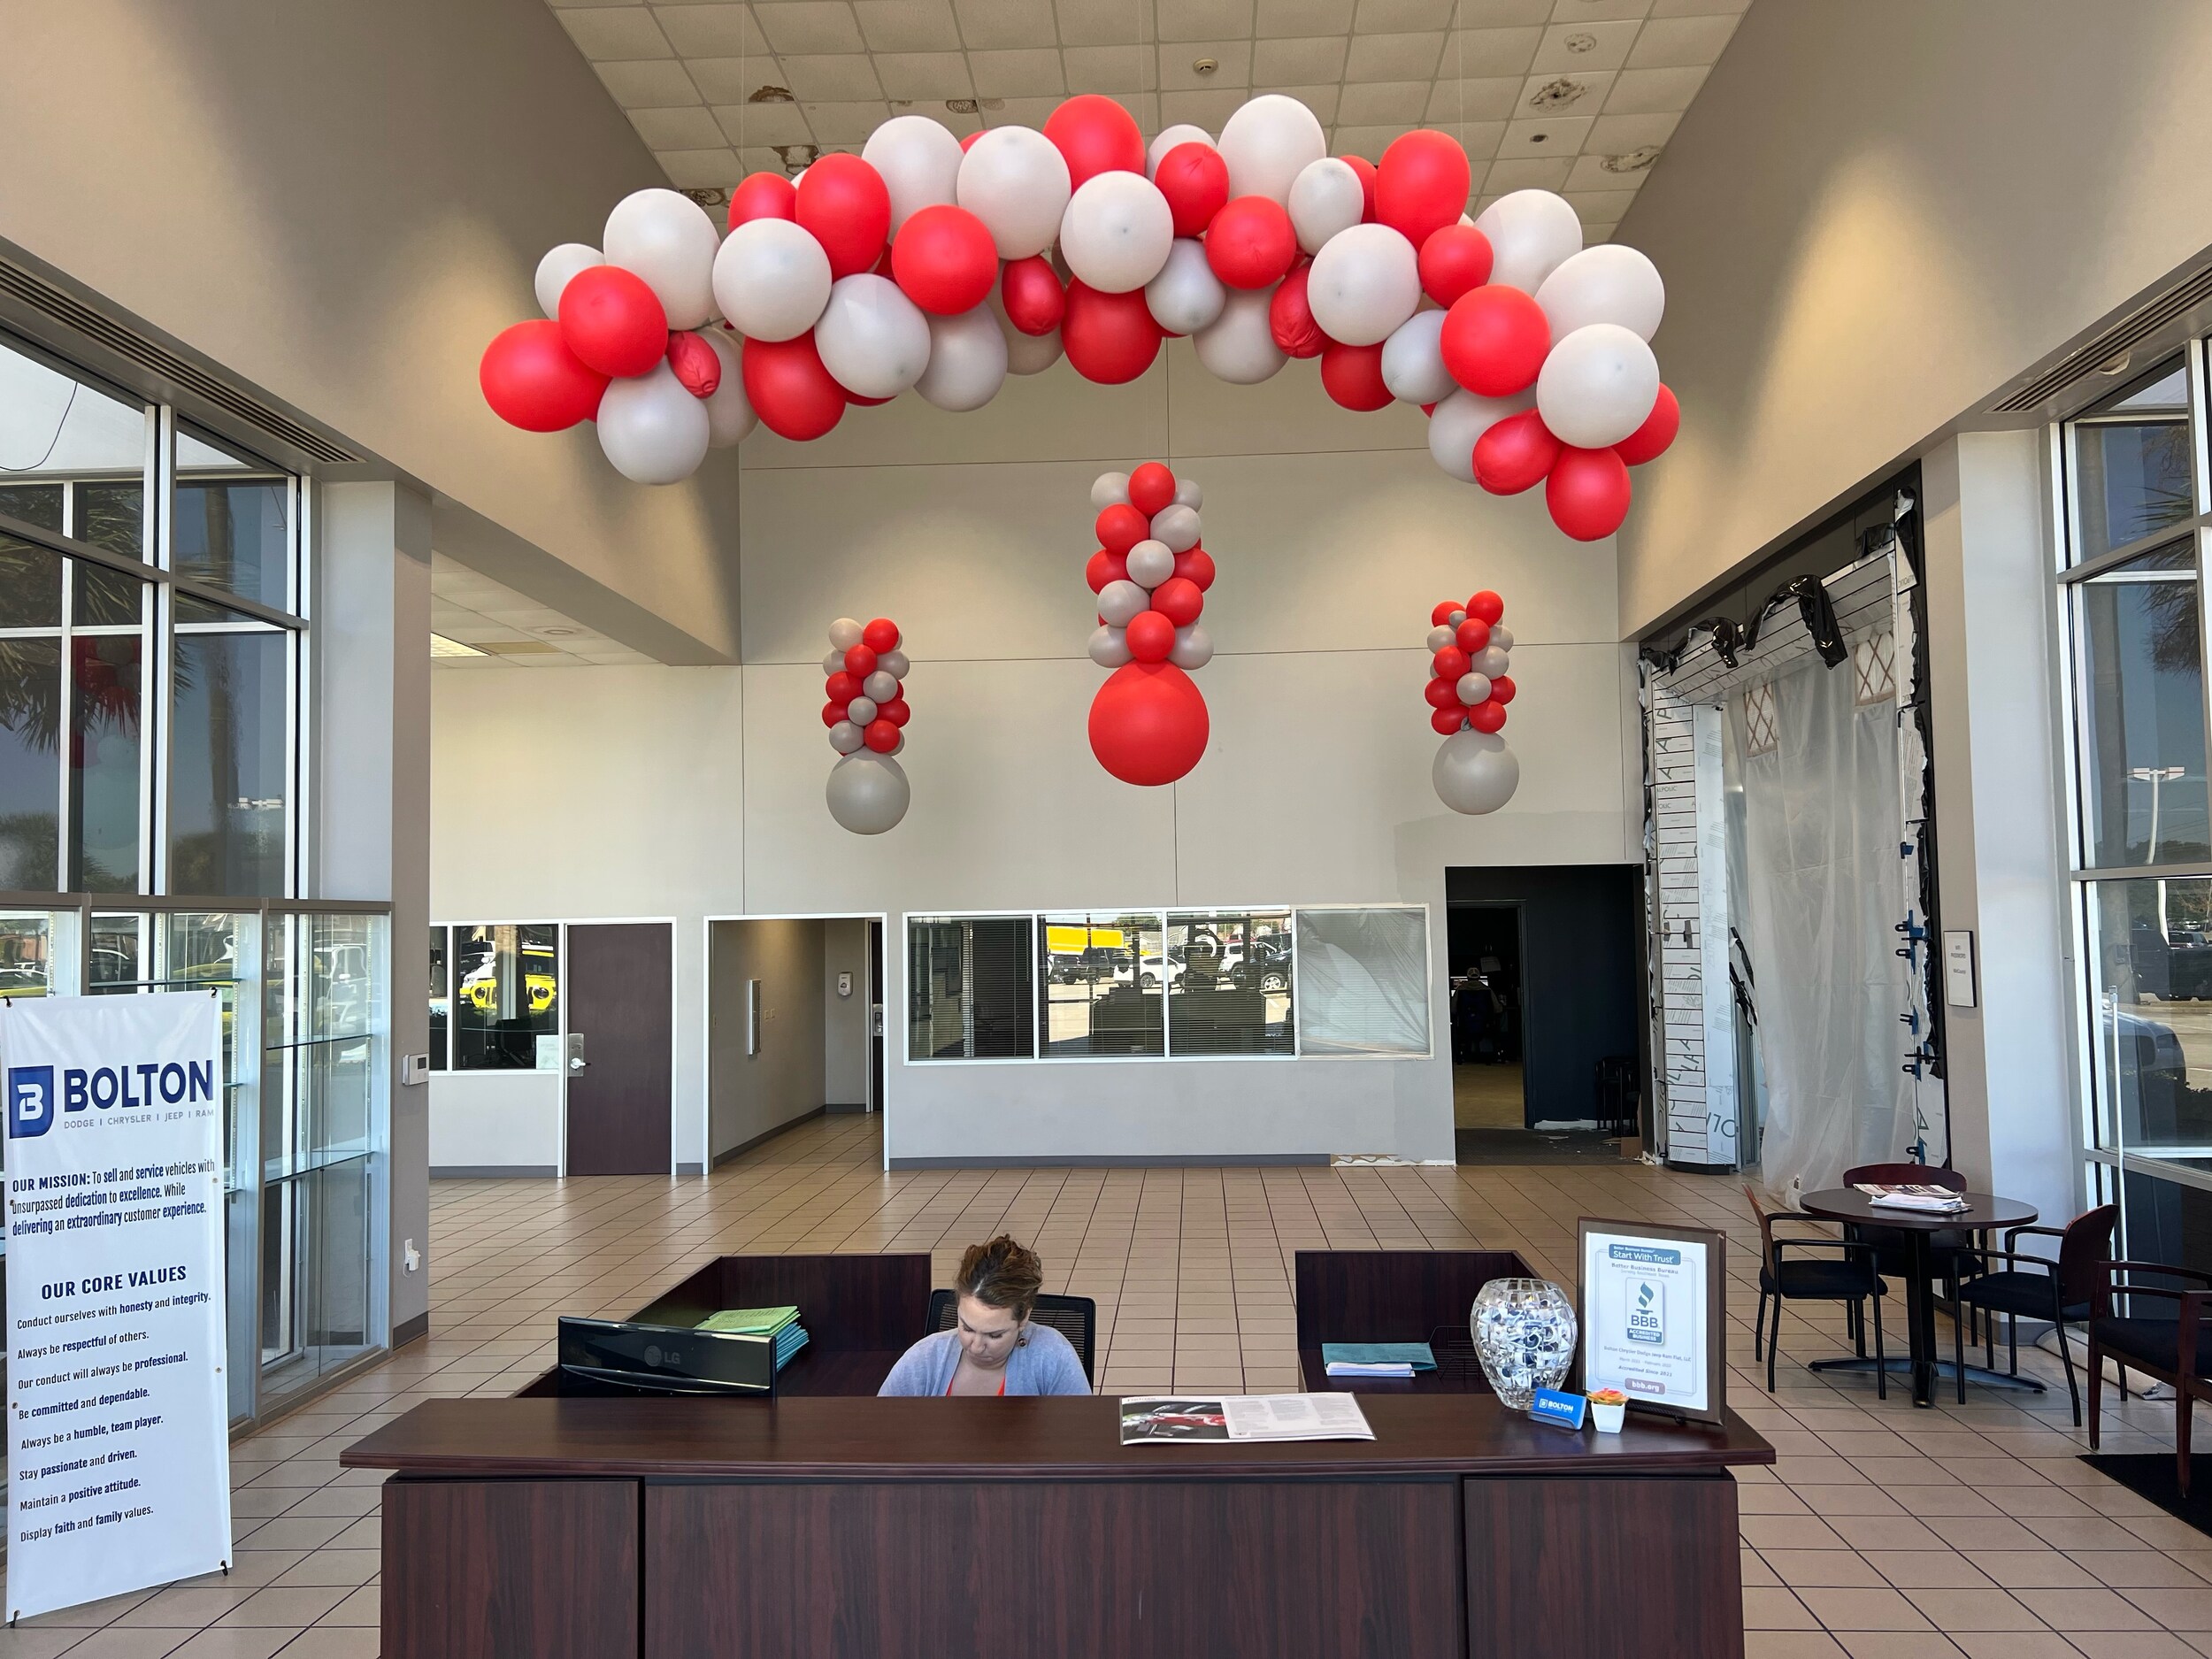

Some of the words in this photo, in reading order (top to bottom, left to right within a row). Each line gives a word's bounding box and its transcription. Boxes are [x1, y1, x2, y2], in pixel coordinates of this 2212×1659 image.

[64, 1059, 214, 1112] BOLTON
[64, 1118, 95, 1129] DODGE
[107, 1114, 151, 1125] CHRYSLER
[165, 1111, 184, 1123] JEEP
[196, 1109, 214, 1118] RAM
[12, 1178, 35, 1192] OUR
[39, 1173, 90, 1190] MISSION:
[92, 1171, 102, 1185] To
[104, 1168, 118, 1183] sell
[119, 1167, 134, 1180] and
[135, 1164, 164, 1179] service
[165, 1161, 196, 1177] vehicles
[197, 1159, 215, 1173] with
[12, 1197, 63, 1215] unsurpassed
[65, 1190, 107, 1209] dedication
[109, 1190, 117, 1203] to
[119, 1186, 162, 1202] excellence.
[164, 1182, 186, 1196] While
[12, 1217, 53, 1236] delivering
[55, 1219, 65, 1231] an
[66, 1210, 122, 1230] extraordinary
[124, 1208, 160, 1223] customer
[163, 1202, 206, 1219] experience.
[1613, 1250, 1632, 1260] Start
[1633, 1252, 1652, 1262] With
[1654, 1254, 1673, 1263] Trust
[42, 1281, 75, 1300] OUR
[81, 1274, 123, 1294] CORE
[127, 1265, 187, 1287] VALUES
[18, 1315, 52, 1329] Conduct
[54, 1309, 96, 1324] ourselves
[98, 1305, 117, 1317] with
[119, 1299, 153, 1314] honesty
[155, 1297, 170, 1309] and
[173, 1291, 211, 1306] integrity.
[1631, 1314, 1658, 1327] BBB
[18, 1347, 47, 1359] Always
[50, 1344, 60, 1355] be
[62, 1335, 107, 1352] respectful
[108, 1333, 118, 1345] of
[119, 1331, 150, 1343] others.
[664, 1351, 680, 1364] LG
[19, 1379, 34, 1389] Our
[35, 1371, 71, 1386] conduct
[73, 1368, 89, 1379] will
[90, 1364, 119, 1378] always
[122, 1362, 133, 1372] be
[134, 1351, 188, 1371] professional.
[1632, 1380, 1660, 1393] bbb.org
[19, 1409, 29, 1419] Be
[31, 1399, 79, 1417] committed
[81, 1396, 96, 1409] and
[99, 1387, 150, 1406] dependable.
[1548, 1400, 1574, 1412] BOLTON
[21, 1436, 51, 1449] Always
[53, 1432, 65, 1443] be
[73, 1425, 109, 1440] humble,
[111, 1421, 133, 1432] team
[134, 1415, 164, 1430] player.
[19, 1468, 39, 1480] Stay
[41, 1458, 88, 1479] passionate
[89, 1454, 105, 1467] and
[108, 1448, 137, 1463] driven.
[19, 1494, 58, 1511] Maintain
[61, 1494, 66, 1502] a
[68, 1485, 103, 1502] positive
[104, 1478, 142, 1494] attitude.
[20, 1527, 53, 1542] Display
[55, 1520, 75, 1534] faith
[77, 1516, 93, 1529] and
[96, 1510, 123, 1525] family
[124, 1506, 154, 1519] values.
